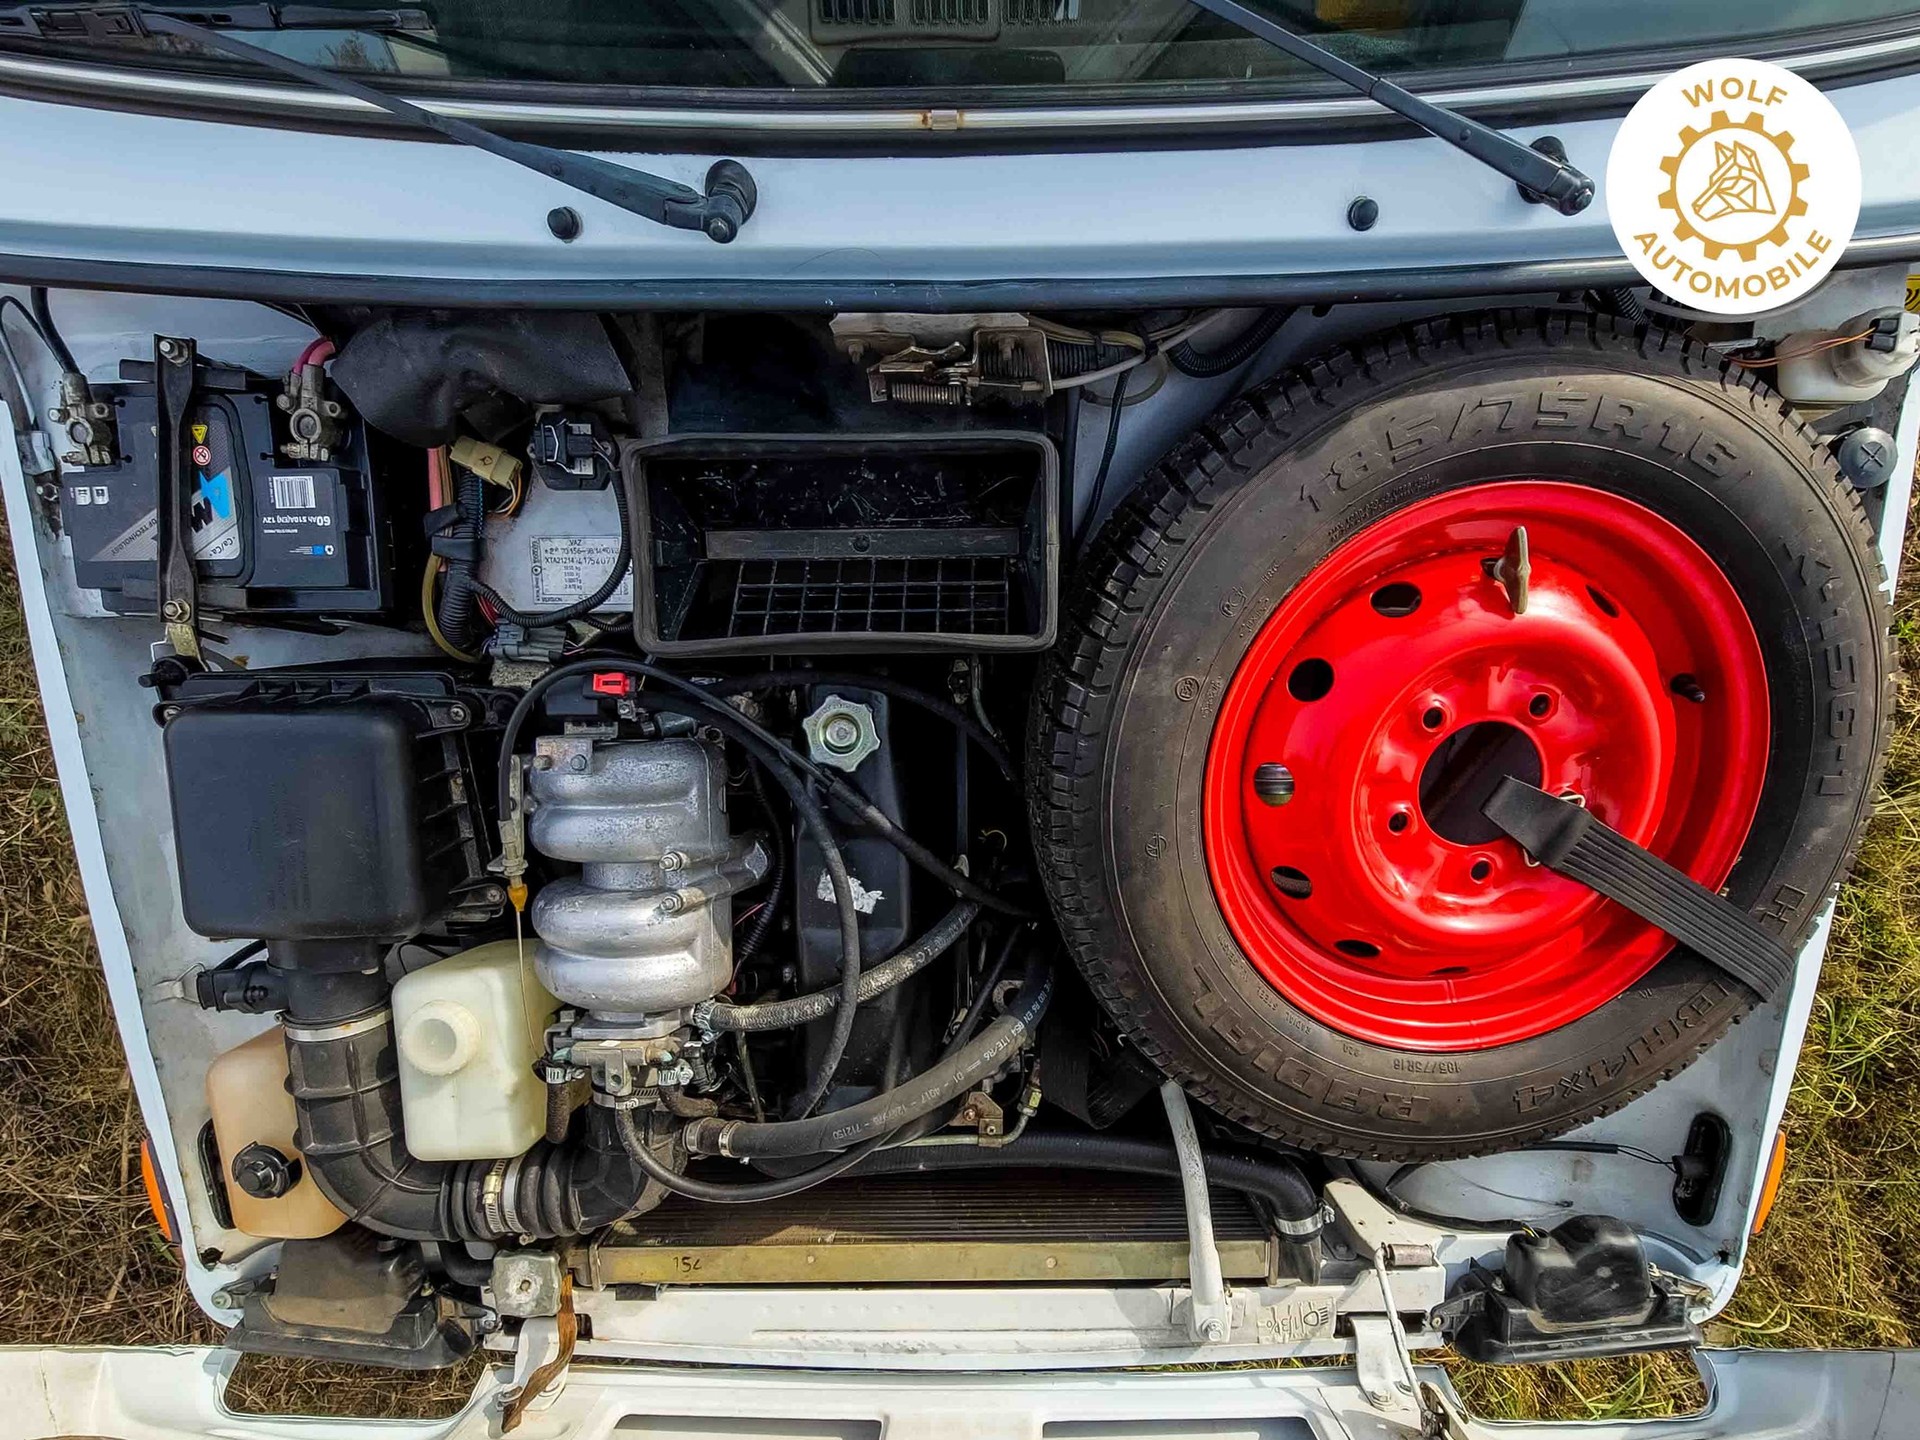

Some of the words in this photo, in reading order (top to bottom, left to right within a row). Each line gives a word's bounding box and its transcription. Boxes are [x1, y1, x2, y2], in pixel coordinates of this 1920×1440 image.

[1298, 391, 1739, 512] 185/75R16
[1023, 1010, 1034, 1023] EN
[1283, 1011, 1312, 1035] RADIAL
[1193, 963, 1430, 1121] RADIAL
[832, 1123, 862, 1140] 712150
